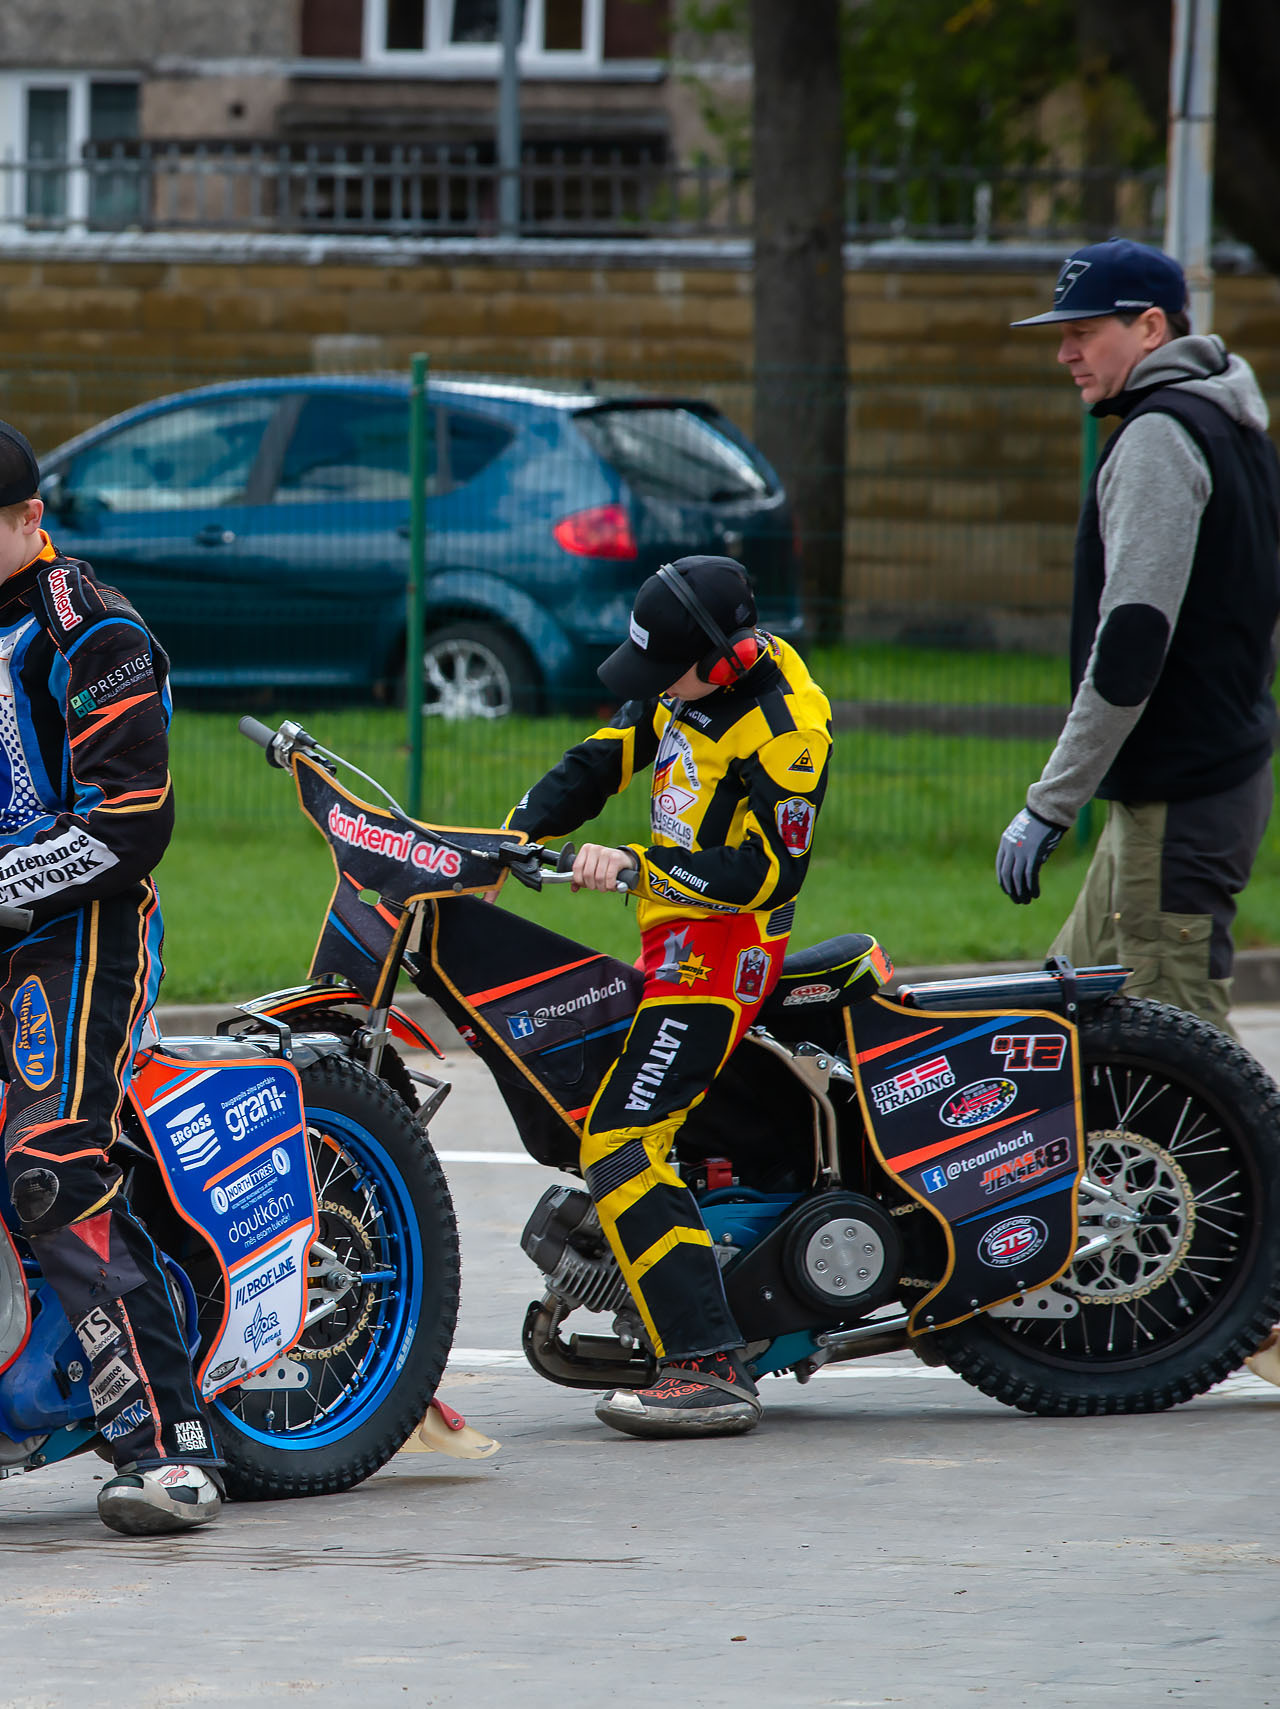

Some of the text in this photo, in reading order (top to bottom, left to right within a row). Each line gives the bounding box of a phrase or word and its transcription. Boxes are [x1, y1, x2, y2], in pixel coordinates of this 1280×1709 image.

[48, 568, 83, 631] dankemi
[88, 653, 152, 698] PRESTIGE
[328, 802, 463, 879] dankemi a/s
[668, 865, 710, 893] FACTORY
[17, 983, 36, 1050] Catering
[533, 976, 628, 1028] @teambach
[624, 1017, 689, 1111] LATVIJA
[873, 1080, 899, 1100] BR
[877, 1071, 954, 1113] TRADING
[170, 1113, 212, 1147] ERGOSS
[946, 1130, 1035, 1181] @teambach
[980, 1151, 1034, 1187] JONAS
[226, 1175, 253, 1200] NORTH
[250, 1162, 275, 1183] TYRES
[984, 1218, 1032, 1244] STAKEFORD
[990, 1227, 1034, 1256] STS
[77, 1310, 111, 1345] TS
[173, 1420, 203, 1434] MALI
